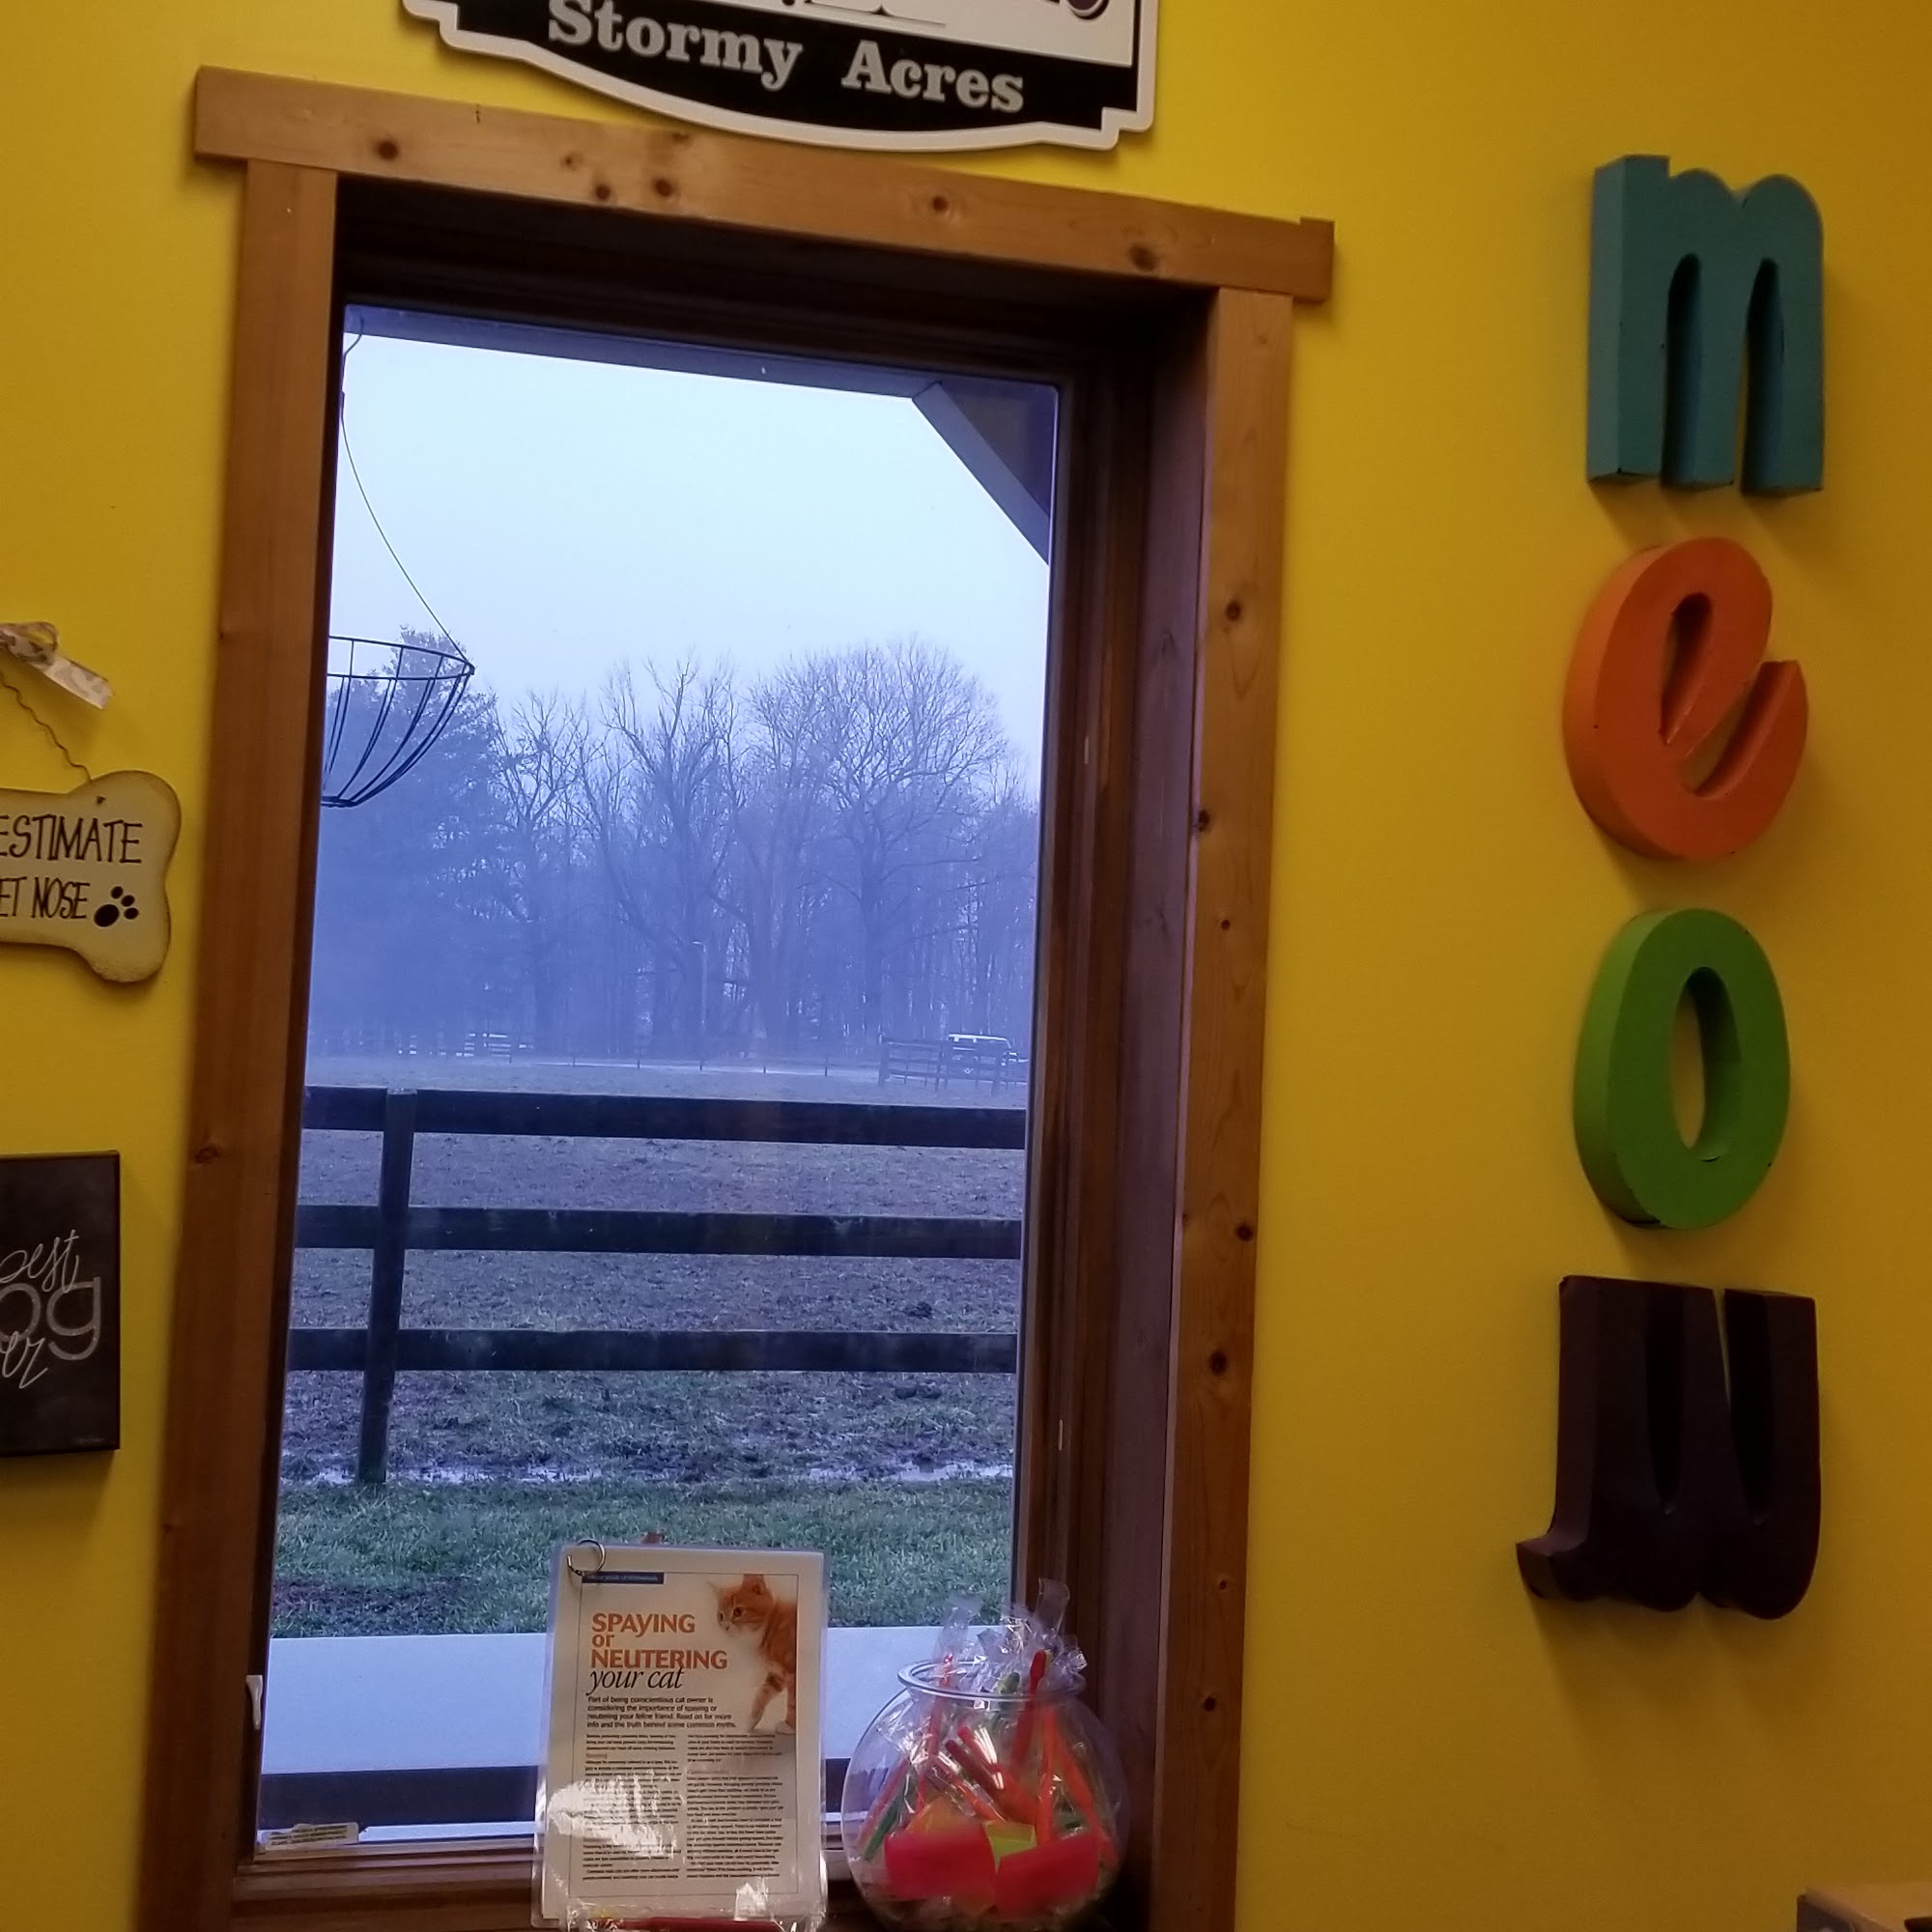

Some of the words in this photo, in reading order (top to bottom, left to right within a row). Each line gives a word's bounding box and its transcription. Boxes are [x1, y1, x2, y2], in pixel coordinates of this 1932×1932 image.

[548, 0, 802, 89] Stormy
[841, 40, 1024, 113] Acres
[31, 876, 90, 919] NOSE
[1516, 153, 1824, 1621] meow
[592, 1612, 696, 1638] SPAYING
[592, 1633, 615, 1648] or
[590, 1649, 728, 1670] NEUTERING
[585, 1668, 645, 1696] your
[647, 1666, 685, 1690] cat
